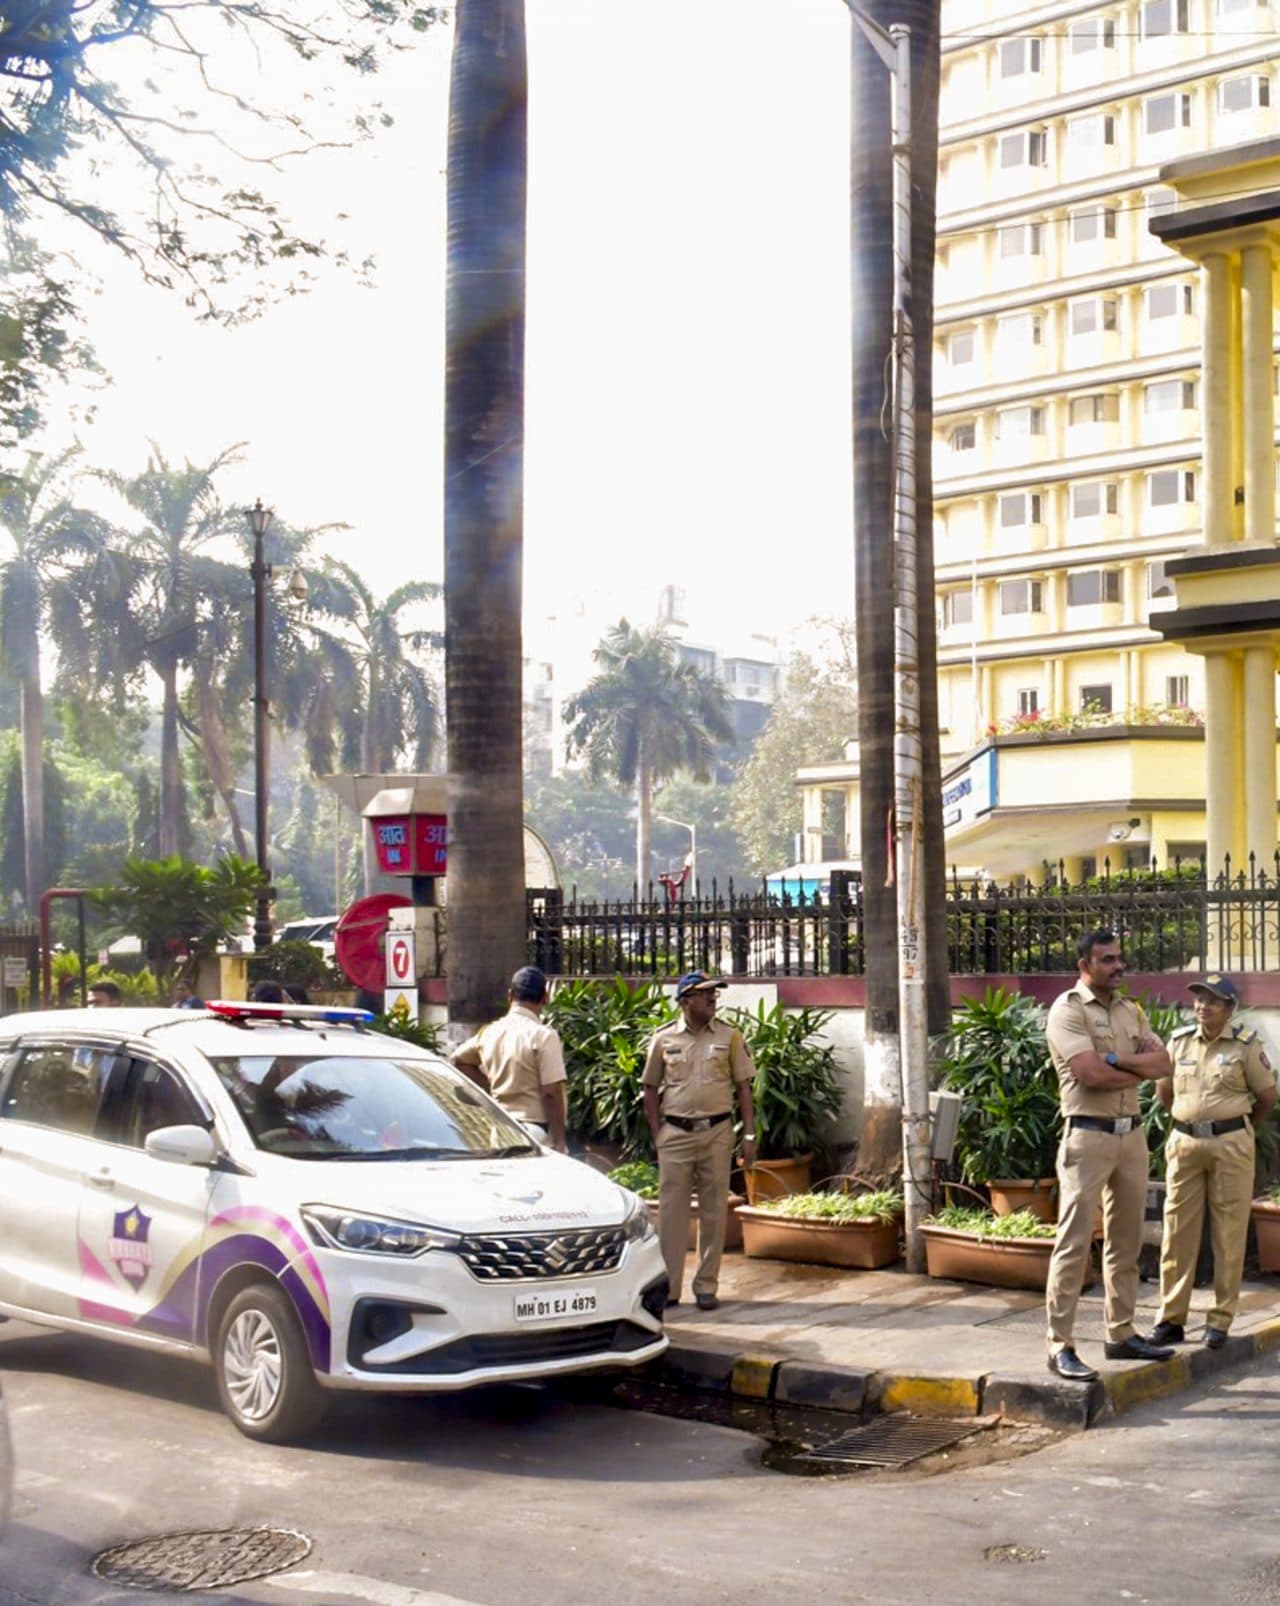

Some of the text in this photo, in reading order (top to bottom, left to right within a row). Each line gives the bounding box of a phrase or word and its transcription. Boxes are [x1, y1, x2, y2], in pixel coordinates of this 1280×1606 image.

[424, 825, 448, 845] आ
[396, 946, 407, 972] 7
[517, 1296, 596, 1317] MH 01 EJ 4879
